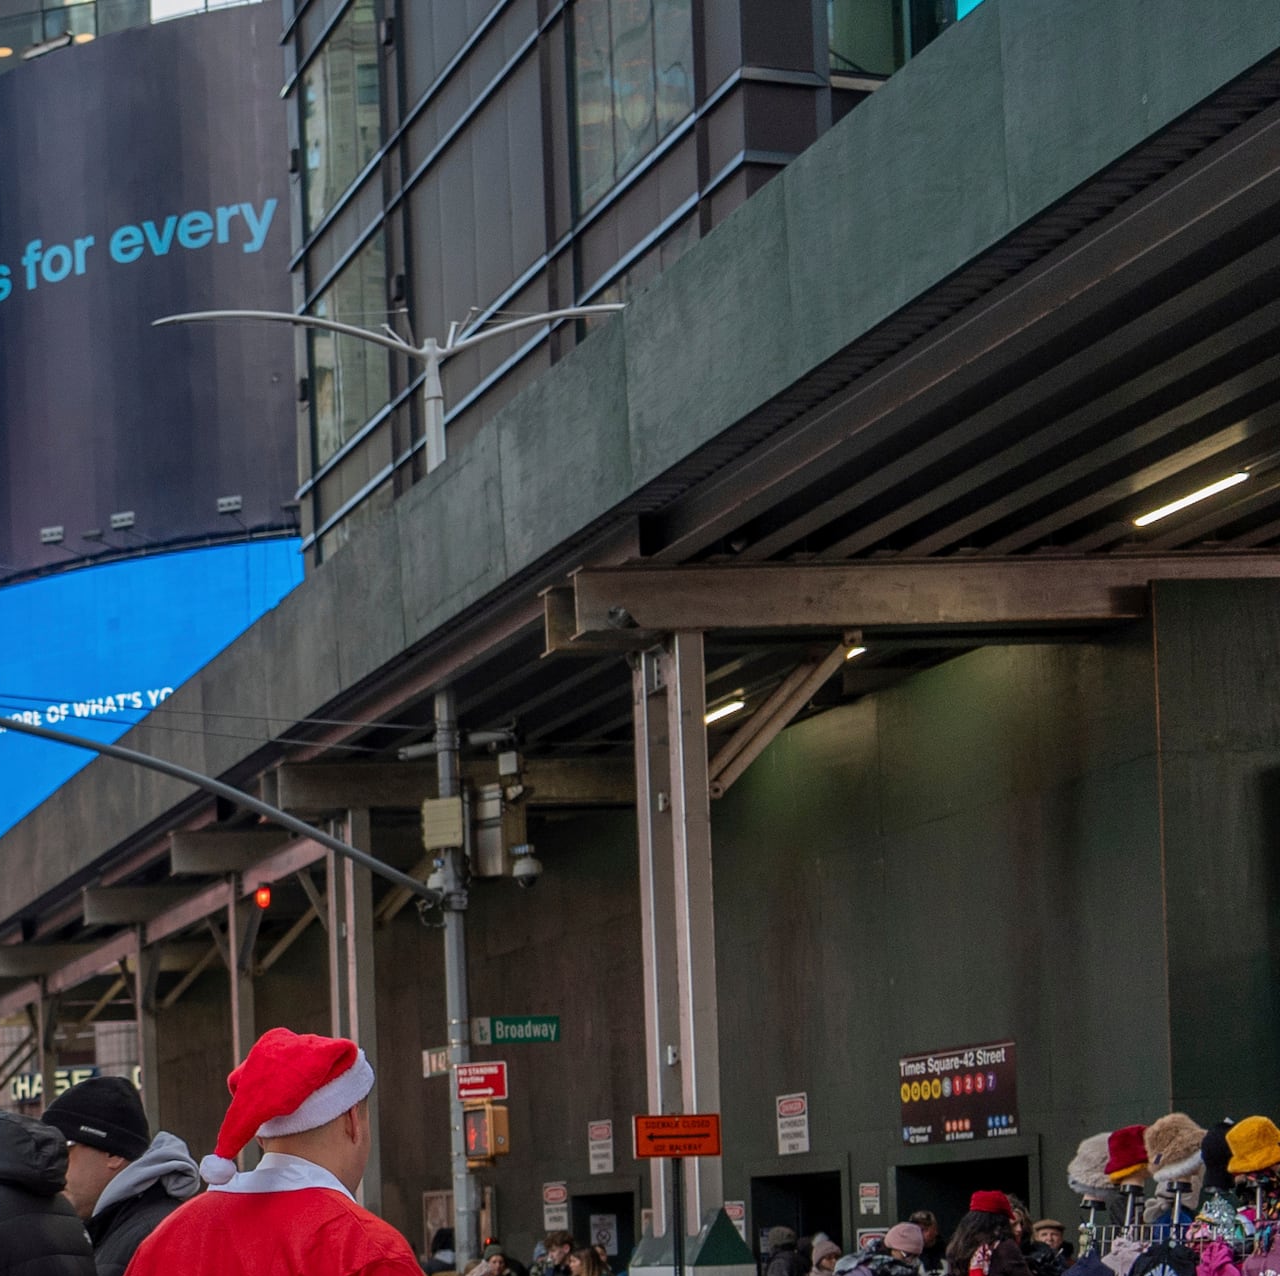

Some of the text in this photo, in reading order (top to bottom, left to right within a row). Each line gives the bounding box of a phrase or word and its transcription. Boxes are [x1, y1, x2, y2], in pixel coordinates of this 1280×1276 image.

[21, 234, 94, 290] for
[110, 198, 278, 264] every
[45, 702, 71, 724] OF
[73, 691, 143, 718] WHAT'S
[495, 1020, 558, 1041] Broadway
[457, 1065, 499, 1076] NO STANDING
[899, 1047, 1006, 1077] Times Square-42 Street
[644, 1119, 710, 1130] SIDEWALK CLOSED
